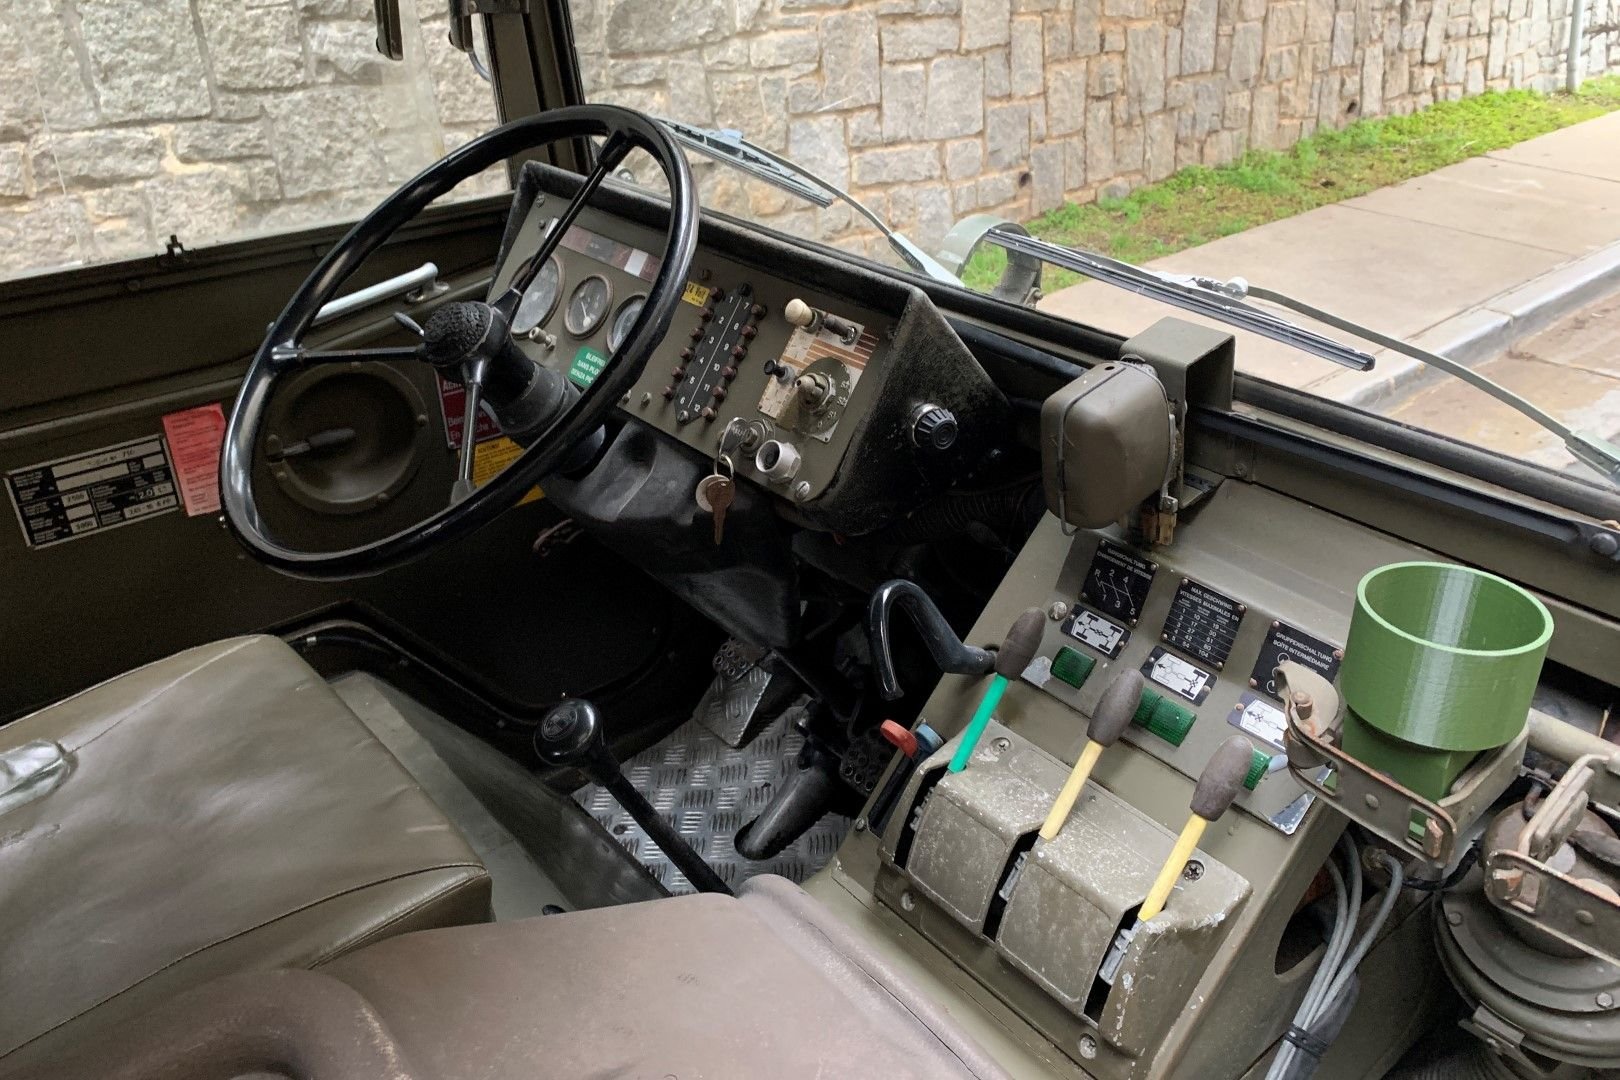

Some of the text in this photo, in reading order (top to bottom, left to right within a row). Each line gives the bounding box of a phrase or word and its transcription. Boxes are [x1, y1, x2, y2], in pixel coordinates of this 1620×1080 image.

[729, 295, 734, 304] 1
[743, 301, 750, 310] 7
[718, 315, 725, 324] 2
[708, 335, 715, 344] 3
[723, 342, 730, 351] 9
[699, 355, 705, 364] 4
[713, 362, 721, 372] 10
[689, 375, 695, 385] 5
[703, 382, 711, 392] 11
[679, 396, 686, 405] 6
[693, 403, 701, 413] 12
[1126, 564, 1134, 572] DE
[1094, 568, 1129, 584] R 2 4
[1114, 600, 1121, 609] 3
[1129, 607, 1136, 616] 5
[1179, 590, 1202, 604] VITESSES
[1202, 600, 1231, 618] MAXIMALES
[1231, 614, 1240, 622] EN
[1193, 613, 1201, 621] 10
[1185, 634, 1193, 642] 42
[1275, 631, 1333, 664] GRUPPENSCHALTUNG
[1198, 649, 1209, 658] 104
